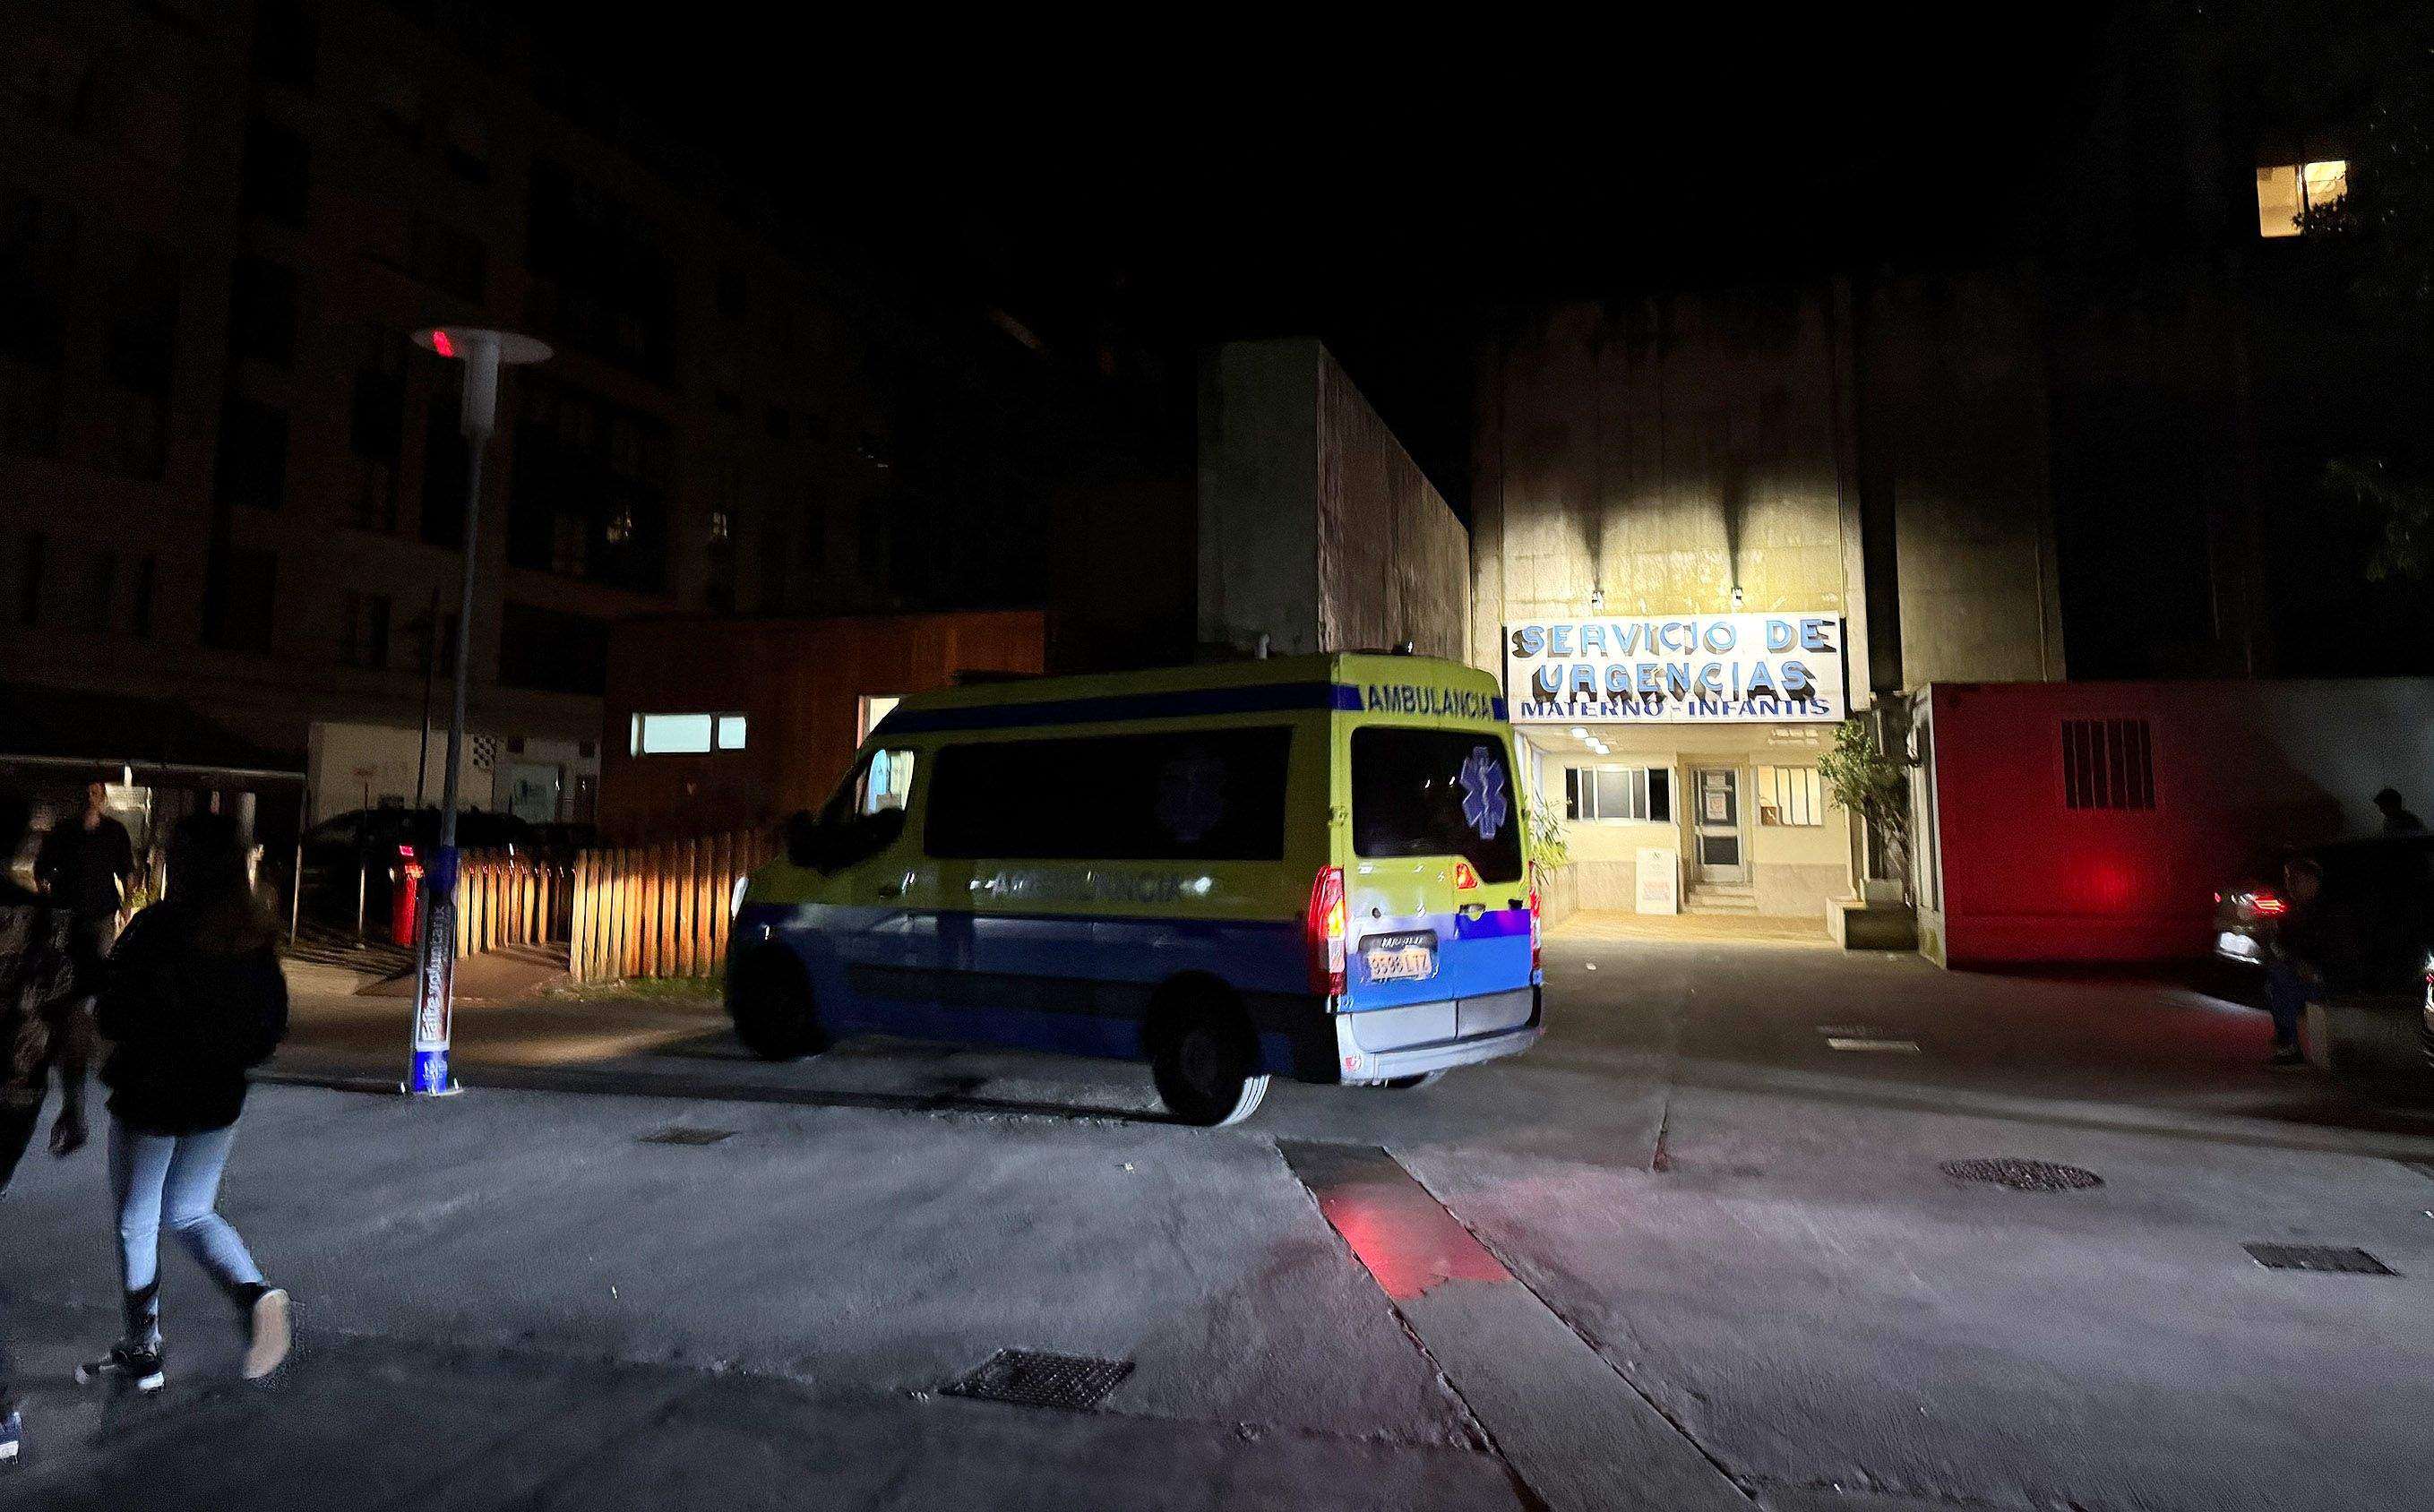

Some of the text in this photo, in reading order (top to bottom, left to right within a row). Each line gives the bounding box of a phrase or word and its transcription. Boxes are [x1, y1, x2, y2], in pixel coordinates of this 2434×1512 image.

[1521, 618, 1825, 657] SERVICIO DE
[1538, 660, 1808, 693] URGENCIAS
